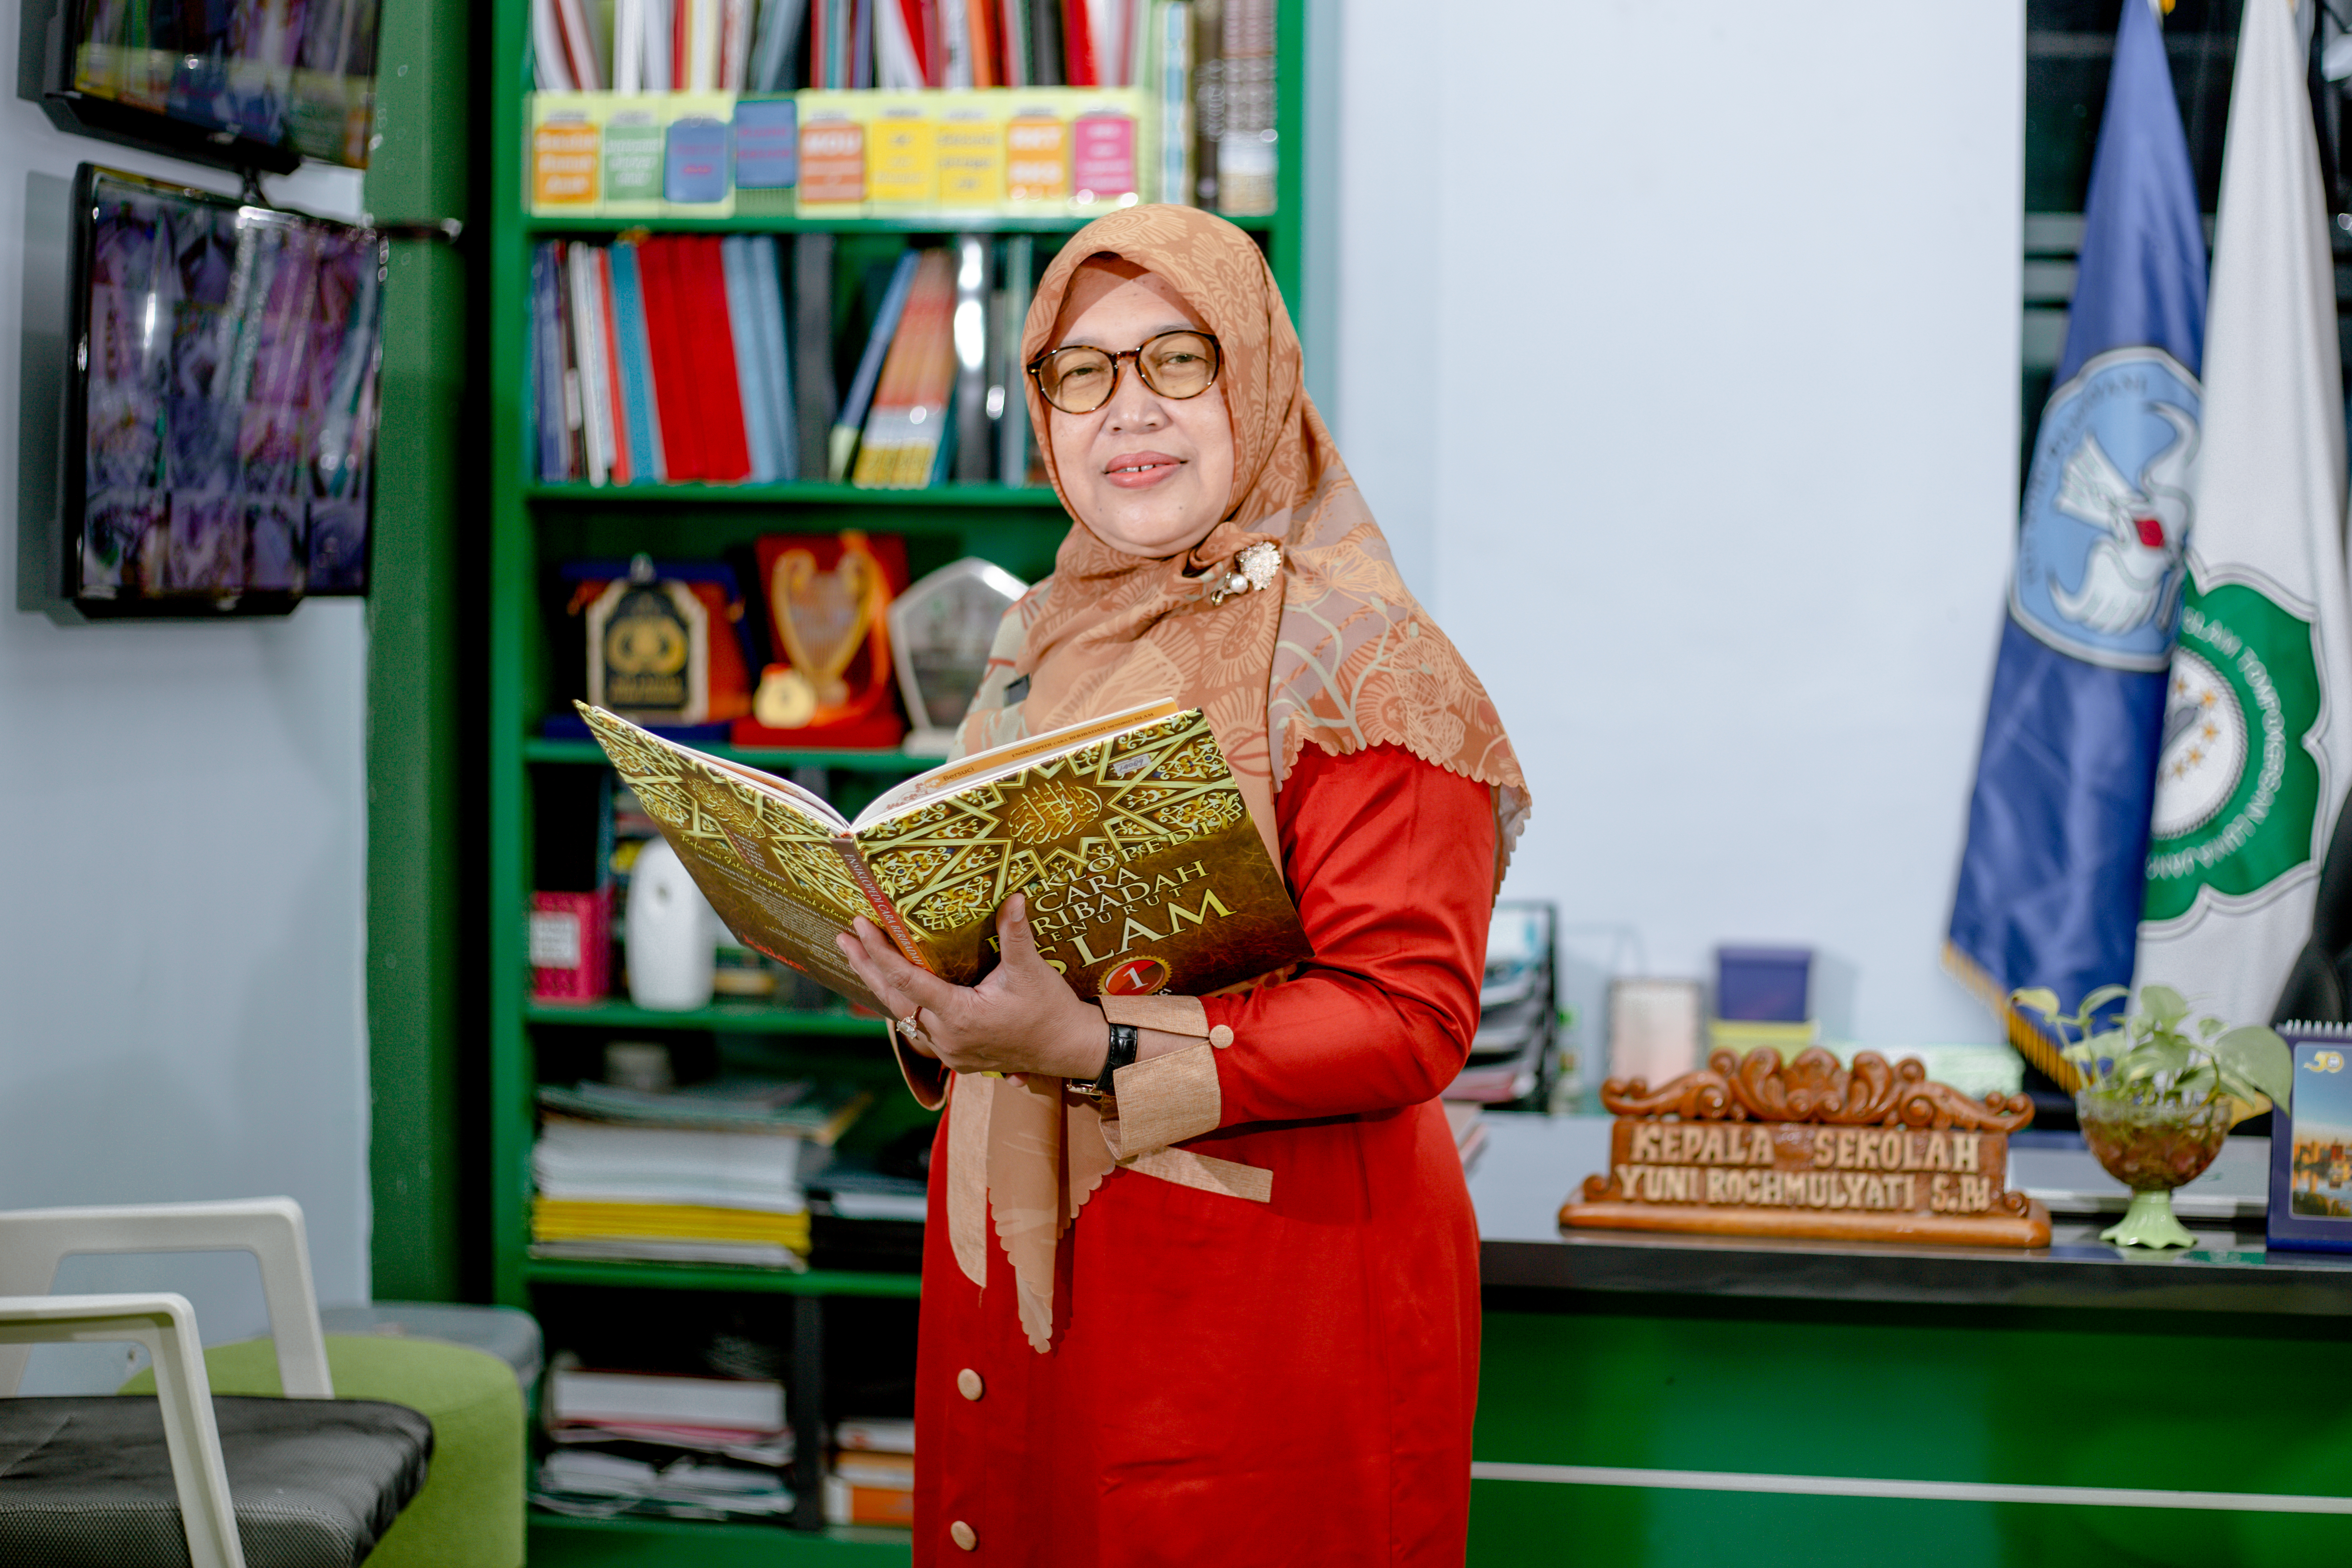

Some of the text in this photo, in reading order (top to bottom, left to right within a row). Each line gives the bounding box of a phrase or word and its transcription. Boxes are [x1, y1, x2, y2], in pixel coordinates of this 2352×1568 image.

[1012, 742, 1052, 758] ENSIKLOPEDI
[1069, 726, 1106, 740] BERIBADAH
[1108, 719, 1133, 729] MENURUT
[1134, 712, 1154, 721] ISLAM
[943, 766, 974, 781] Bersuci
[681, 834, 853, 926] Referensi Islam lengkap untuk keluarg
[1035, 867, 1143, 912] CARA
[822, 915, 860, 936] MENURU
[845, 854, 924, 965] ENSIKLOPEDI CARA BERIBADAH
[1034, 885, 1185, 948] ENURUT
[1123, 967, 1149, 991] 1
[1630, 1122, 1981, 1172] KEPALA SEKOLAH
[1615, 1163, 1699, 1202] YUNI
[1706, 1166, 1916, 1210] ROCHMULYATI
